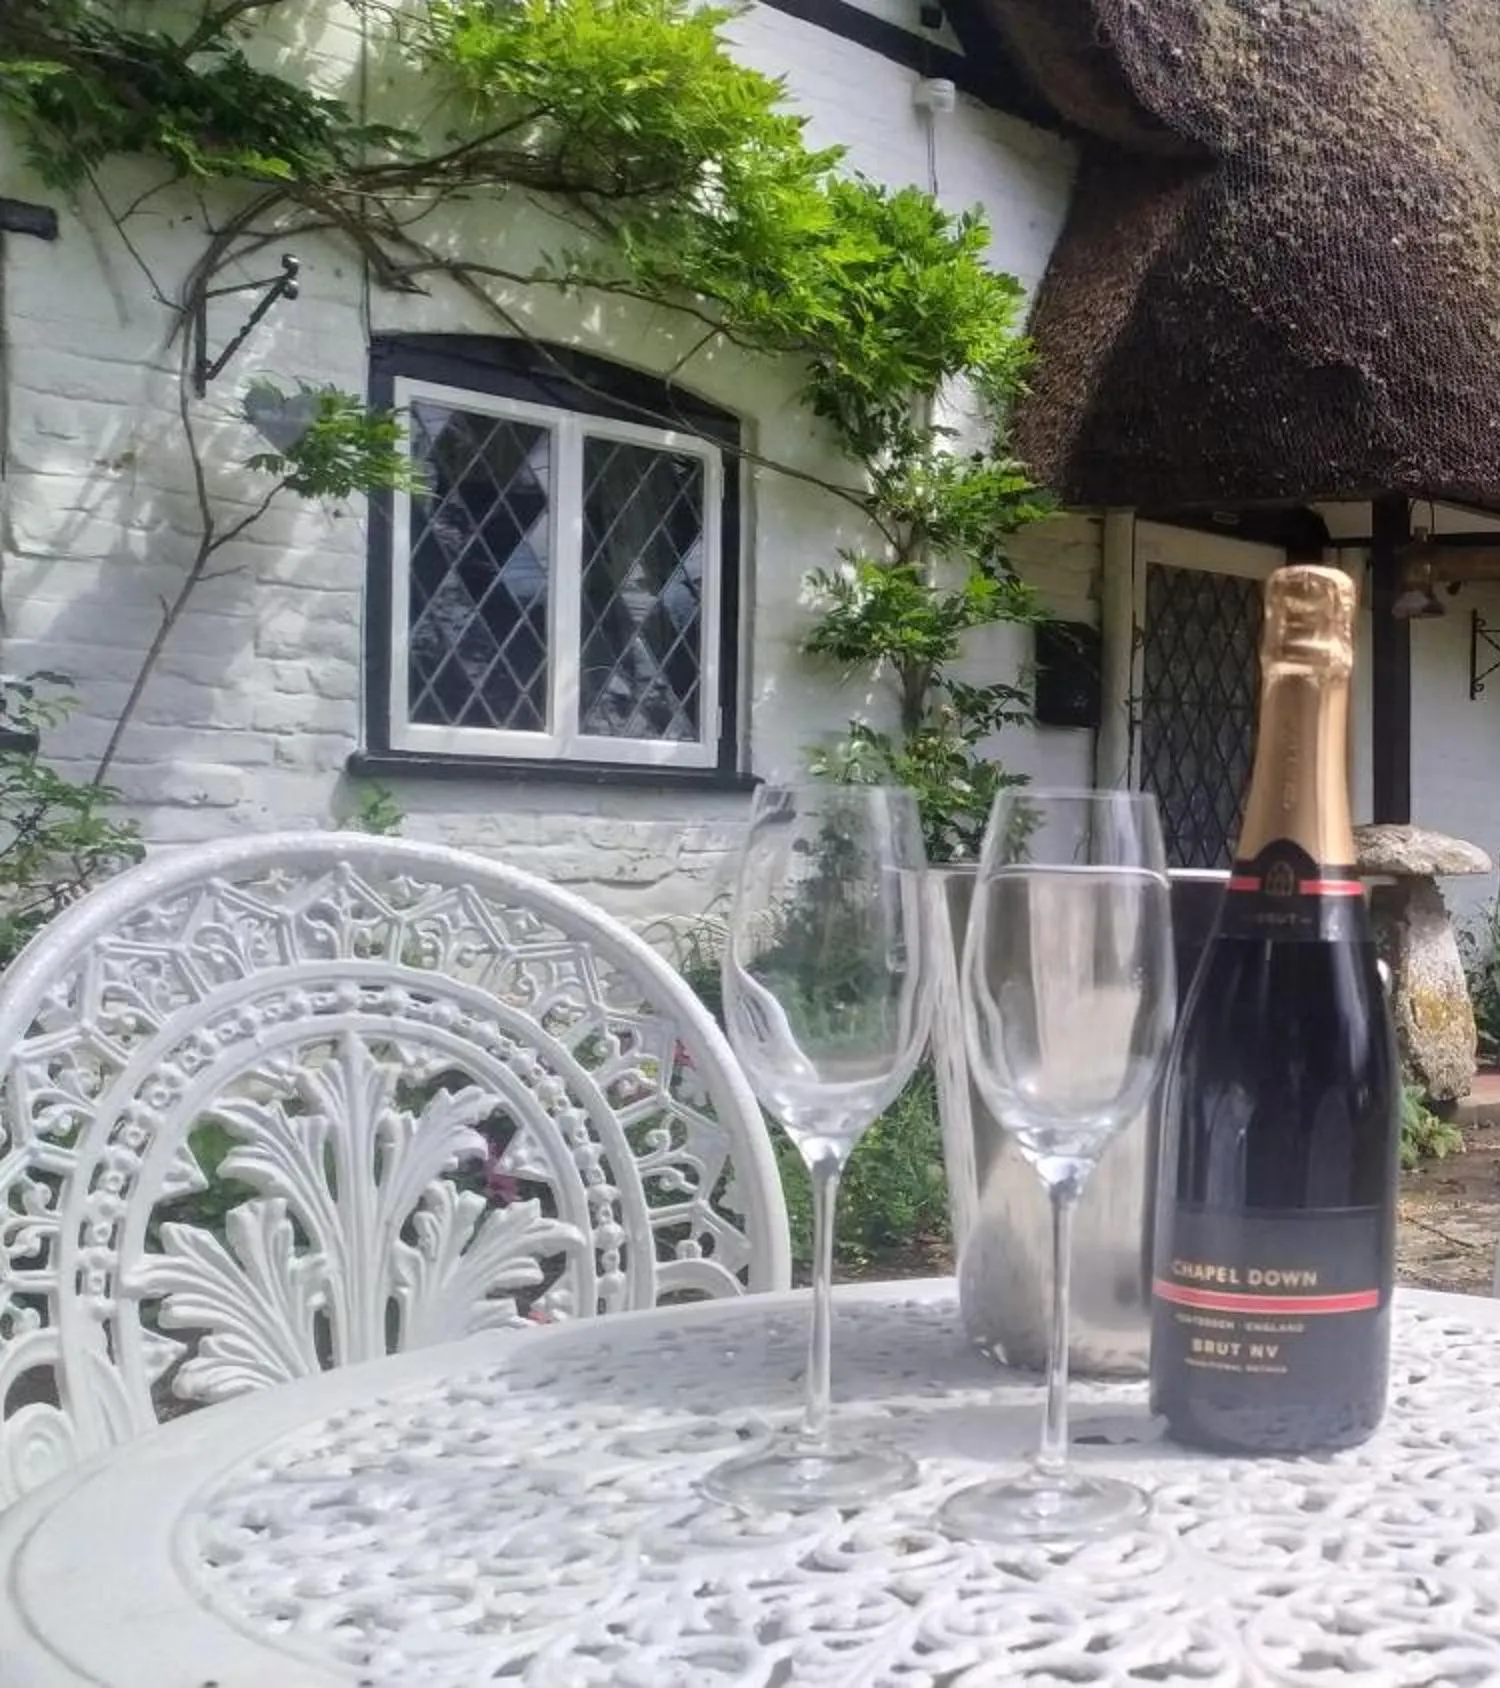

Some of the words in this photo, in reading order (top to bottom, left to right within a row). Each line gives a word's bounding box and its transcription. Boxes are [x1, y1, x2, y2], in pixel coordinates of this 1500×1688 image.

[1172, 1259, 1240, 1285] CHAPEL
[1247, 1268, 1318, 1288] DOWN
[1191, 1337, 1241, 1357] BRUT
[1249, 1343, 1279, 1359] NV
